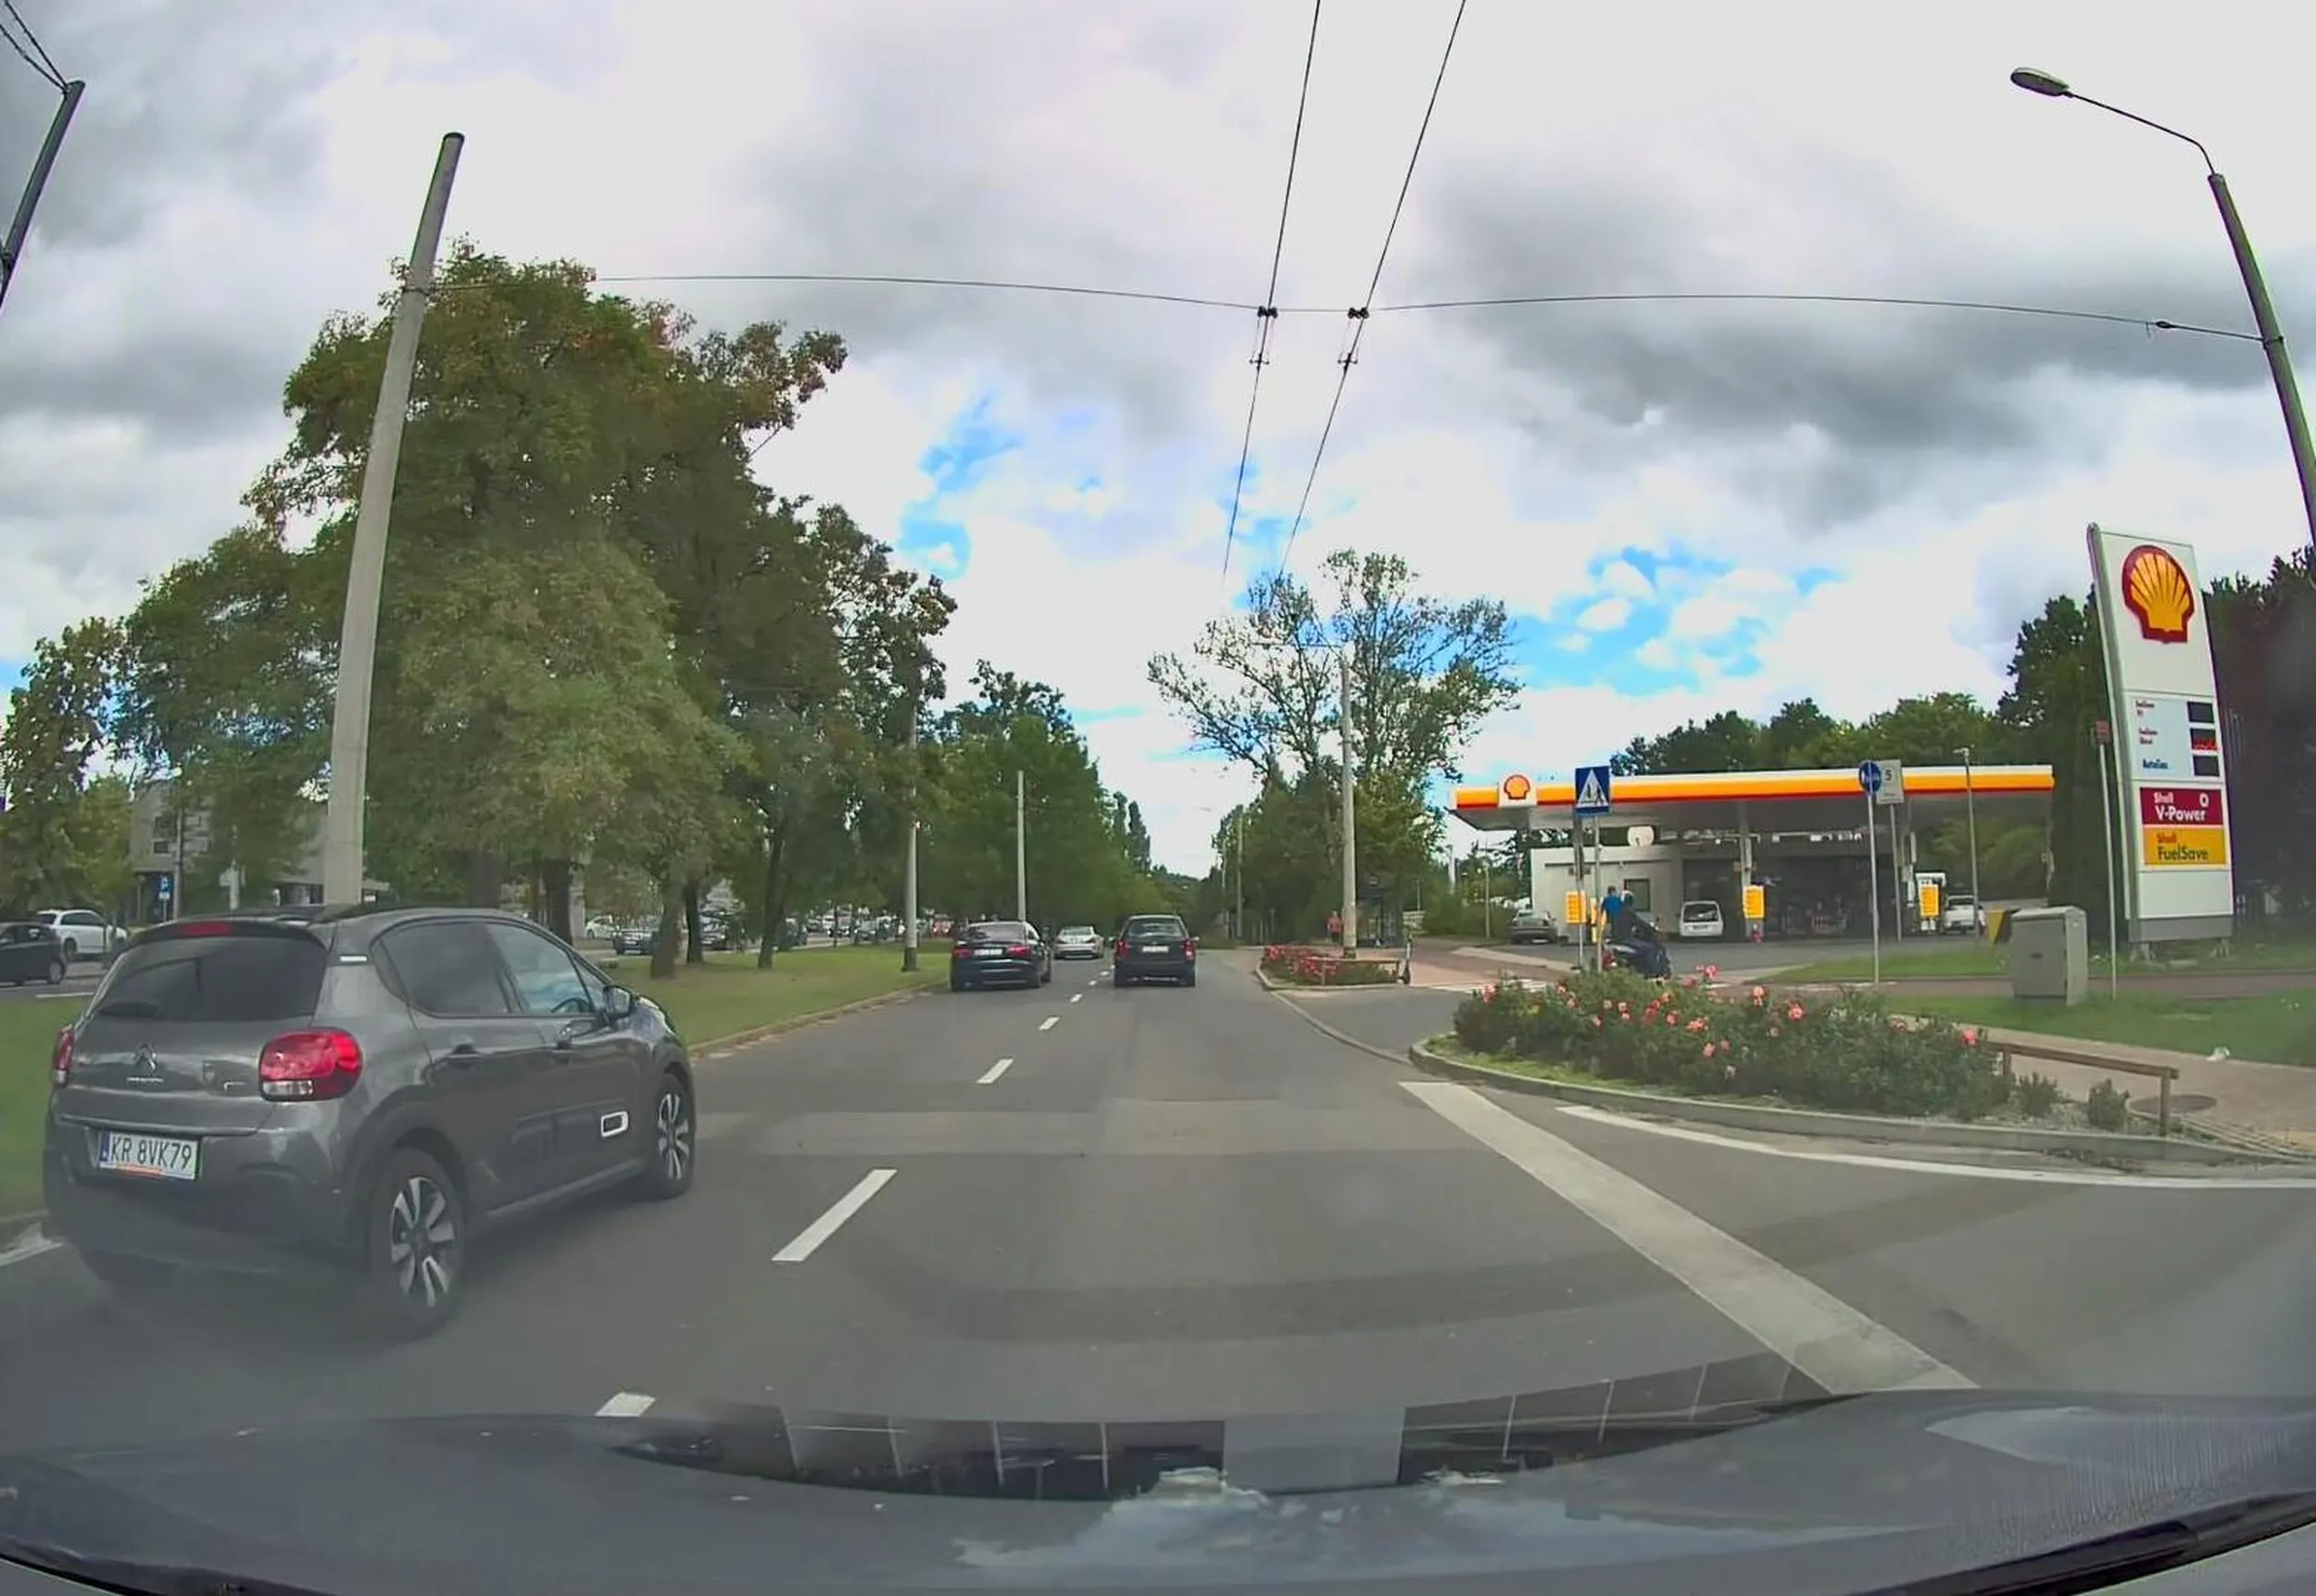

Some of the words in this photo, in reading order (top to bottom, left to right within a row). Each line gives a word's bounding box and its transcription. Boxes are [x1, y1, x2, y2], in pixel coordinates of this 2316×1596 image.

[2153, 791, 2174, 804] Shell
[2155, 804, 2207, 822] V-Power
[2157, 843, 2209, 861] FuelSave
[112, 1136, 132, 1162] KR
[138, 1140, 193, 1169] 8VK79
